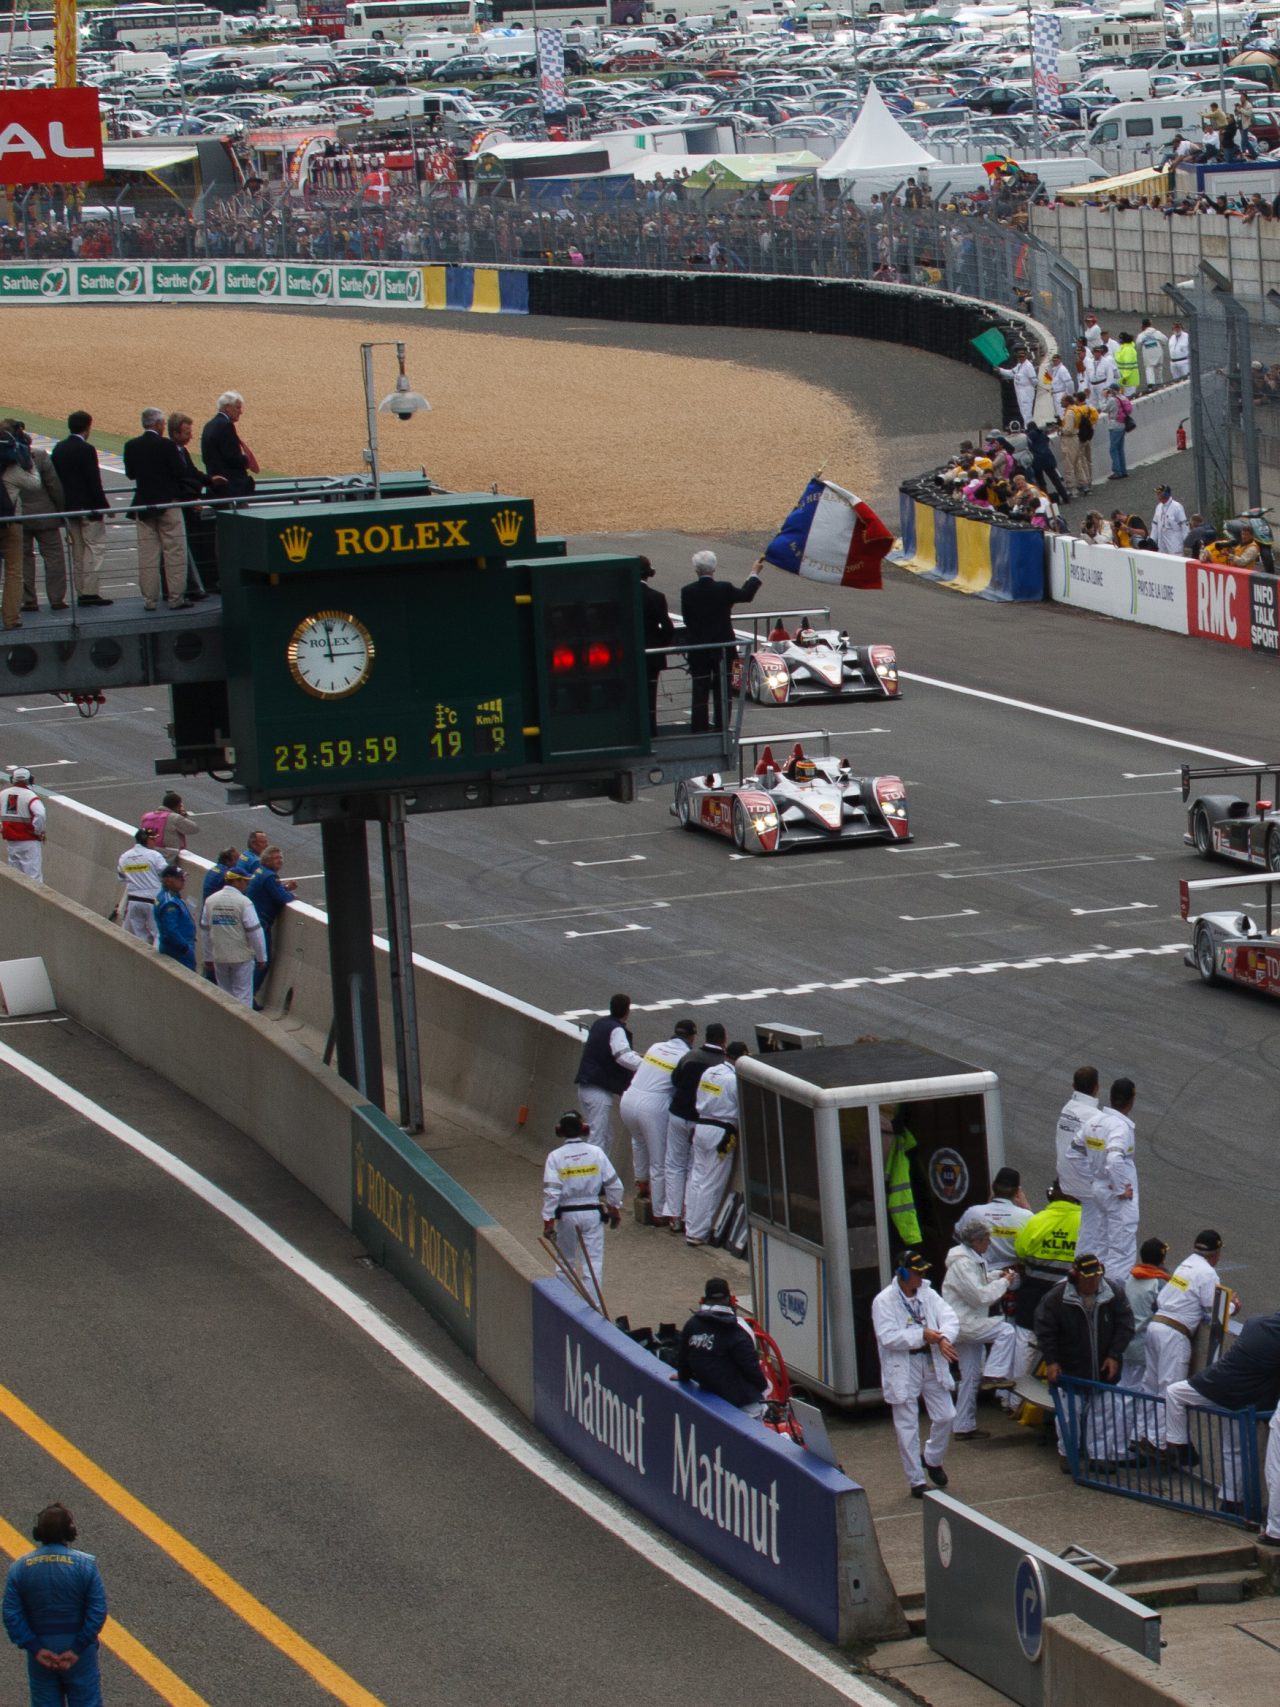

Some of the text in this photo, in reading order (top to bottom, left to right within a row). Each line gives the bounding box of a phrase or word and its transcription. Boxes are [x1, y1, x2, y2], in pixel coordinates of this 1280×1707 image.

[3, 275, 39, 290] Sarthe
[81, 274, 115, 289] Sarthe
[157, 273, 188, 288] Sarthe
[227, 273, 257, 288] Sarthe
[288, 274, 311, 290] Sarthe
[341, 277, 363, 291] Sarthe
[386, 279, 407, 294] Sarthe
[335, 519, 471, 556] ROLEX
[1253, 584, 1273, 606] INFO
[1197, 568, 1238, 641] RMC
[1254, 604, 1275, 627] TALK
[310, 637, 350, 648] ROLEX
[1251, 624, 1279, 649] SPORT
[476, 715, 500, 725] Km/h
[430, 731, 462, 758] 19
[275, 735, 397, 772] 23:59:59
[881, 791, 905, 801] TDI
[749, 805, 771, 813] TDI
[1214, 831, 1221, 848] 7
[368, 1163, 460, 1301] ROLEX ROLEX
[1042, 1239, 1076, 1250] KLM
[564, 1333, 781, 1565] Matmut Matmut
